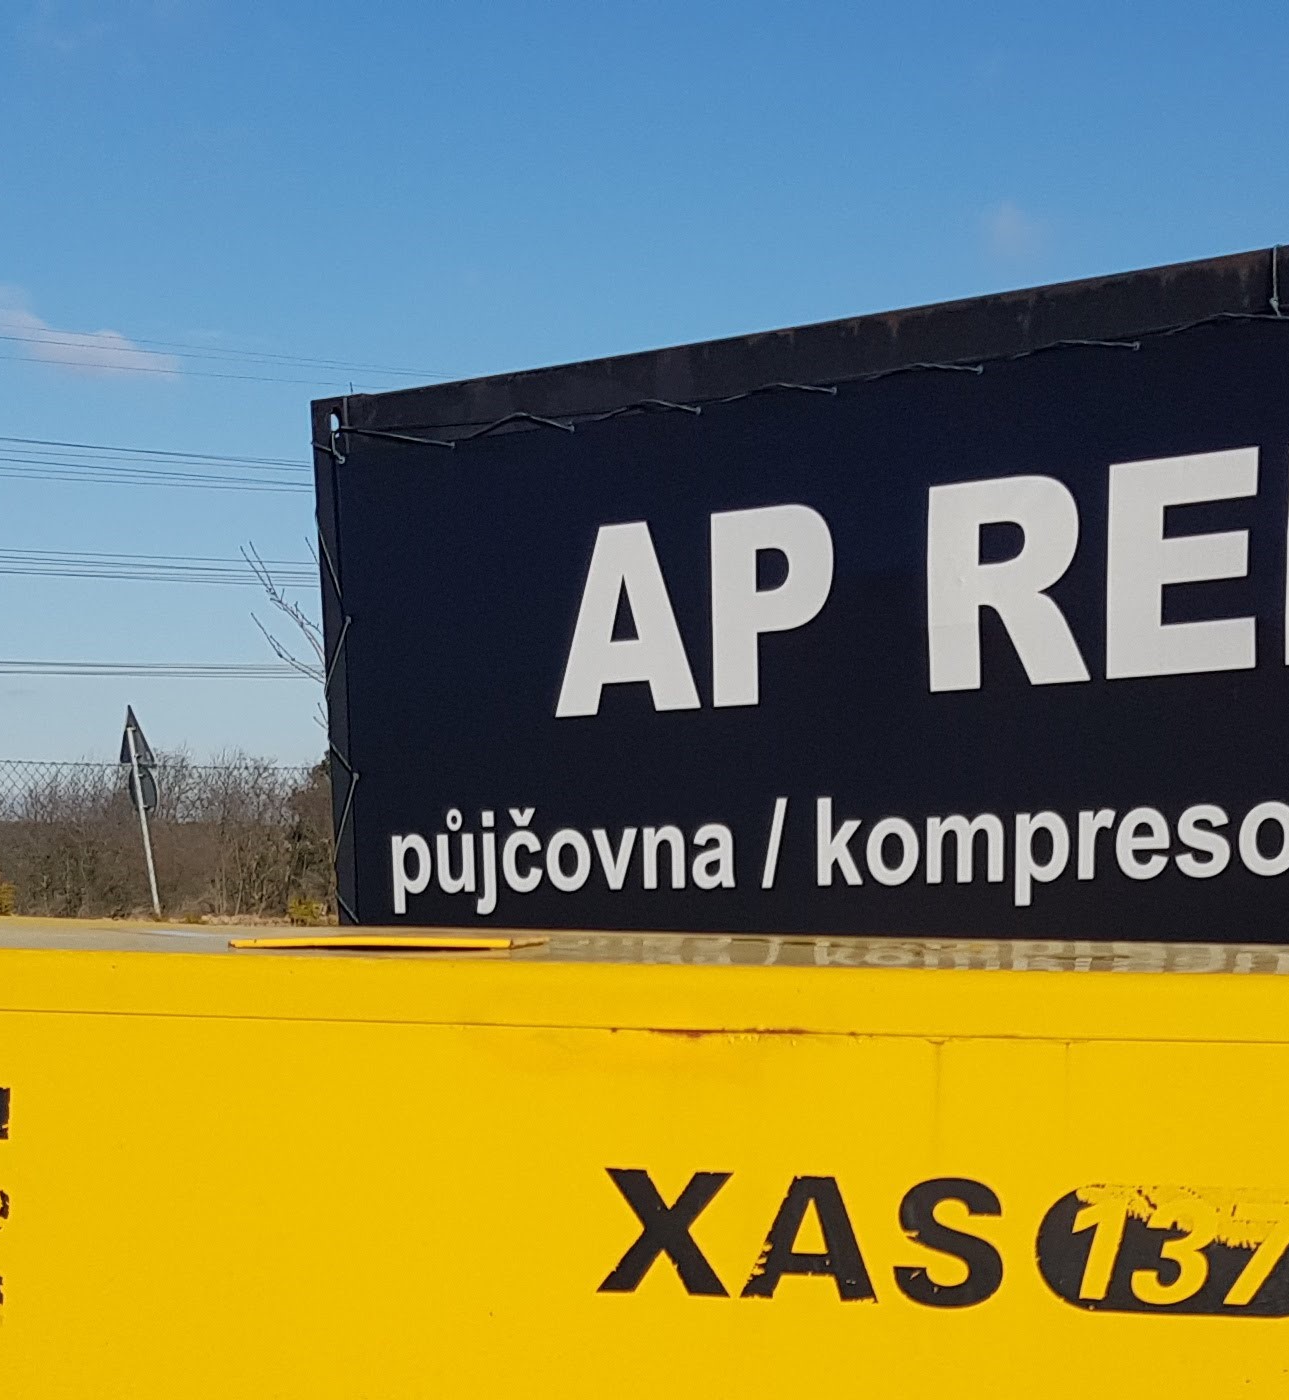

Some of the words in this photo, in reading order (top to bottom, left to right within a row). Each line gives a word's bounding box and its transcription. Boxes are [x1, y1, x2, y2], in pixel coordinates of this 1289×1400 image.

[555, 503, 834, 718] AP
[391, 808, 736, 916] půjčovna
[595, 1167, 1005, 1309] XAS
